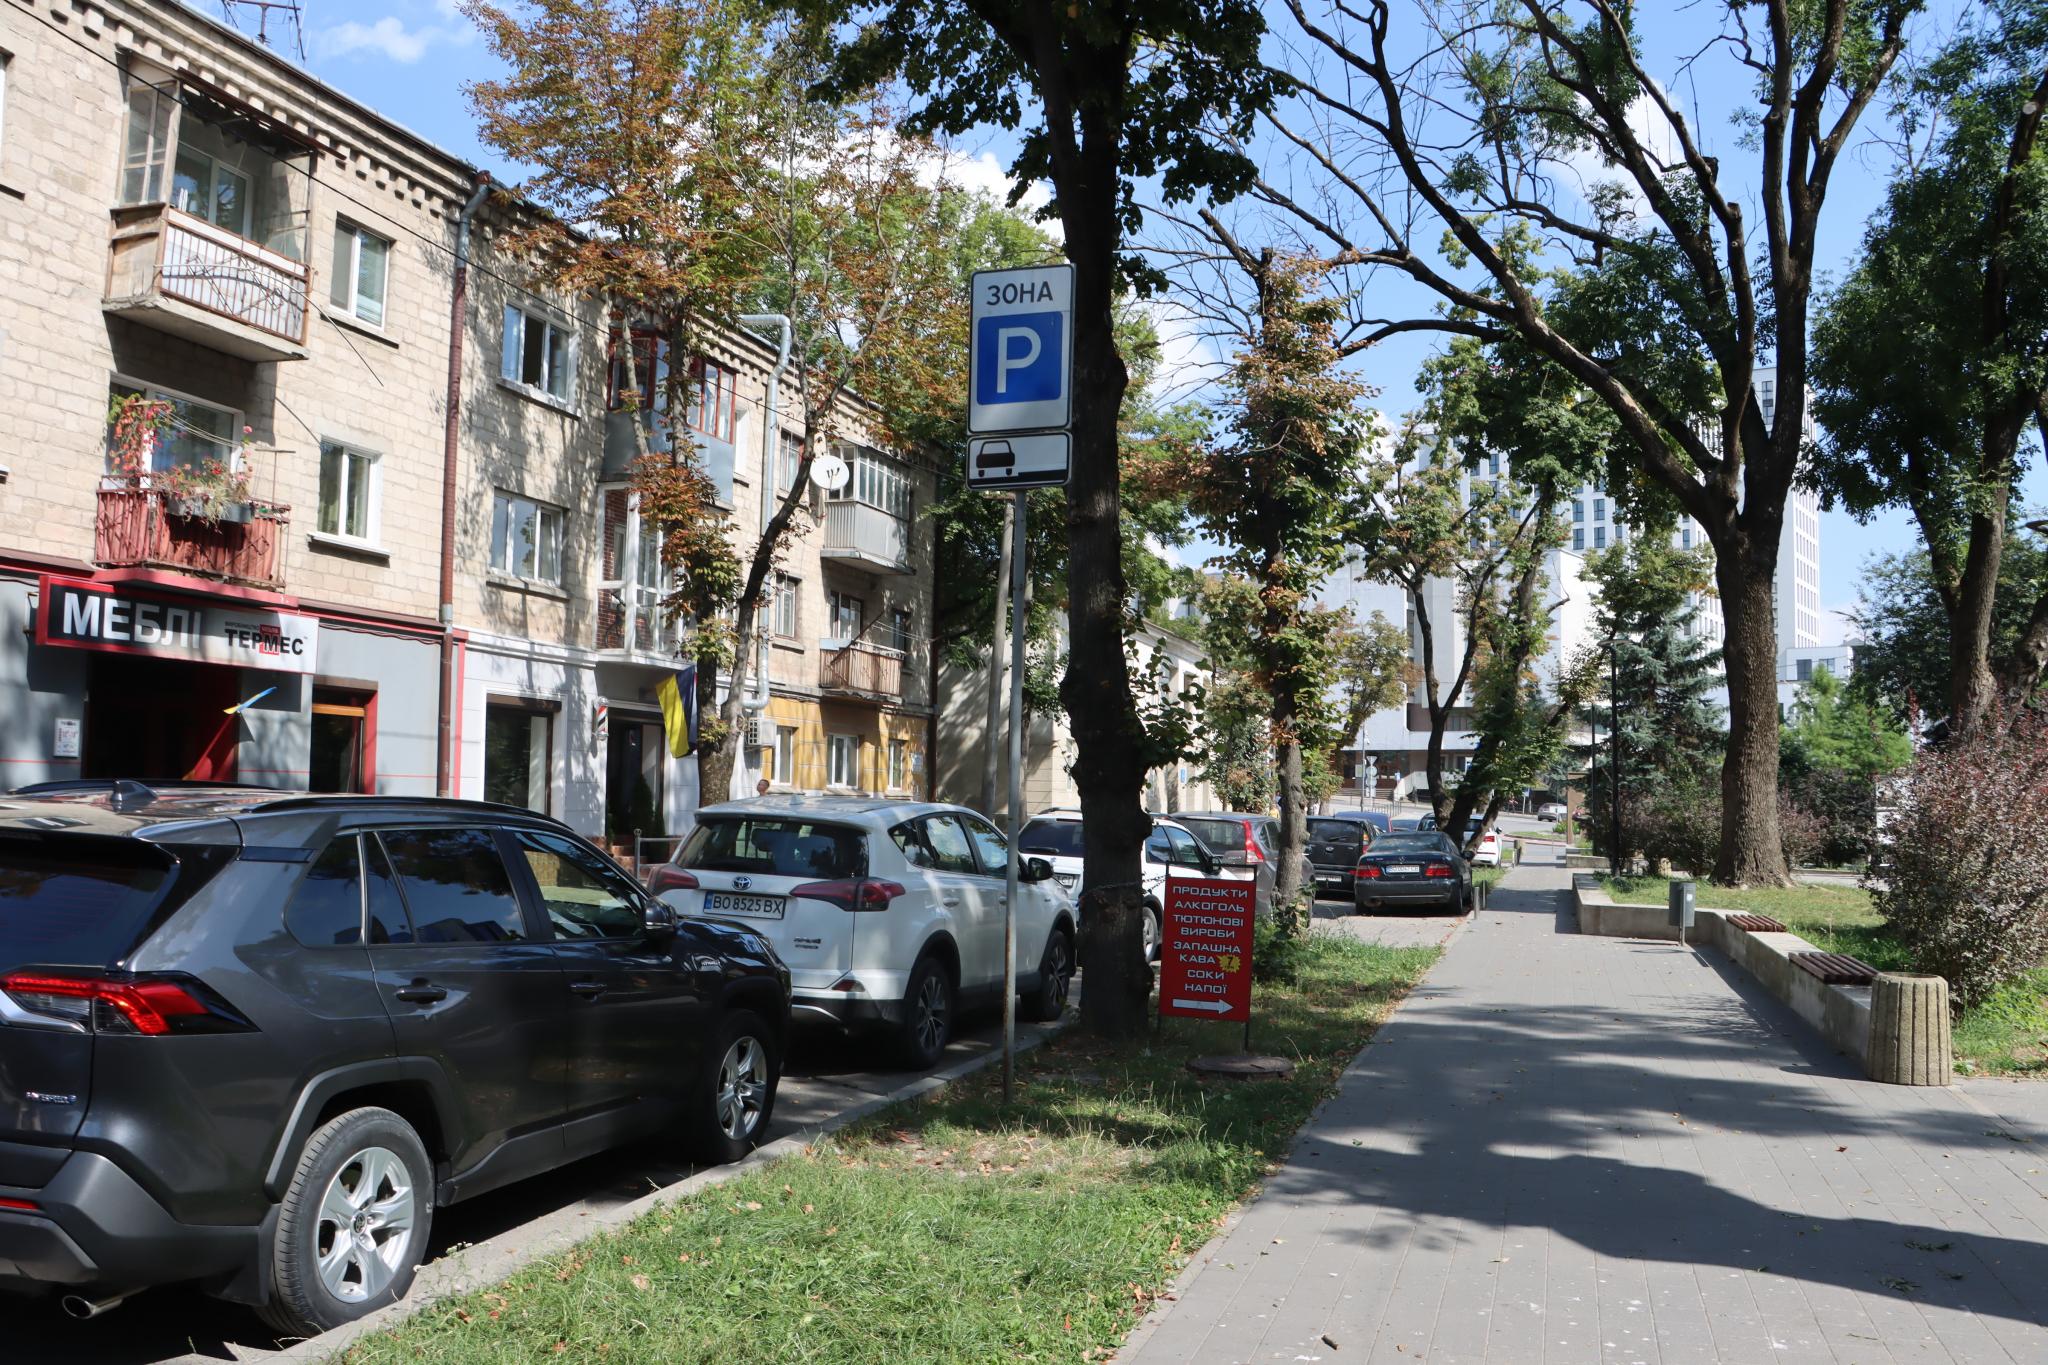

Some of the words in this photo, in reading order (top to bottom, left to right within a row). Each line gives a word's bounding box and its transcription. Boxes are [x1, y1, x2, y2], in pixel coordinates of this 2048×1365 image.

[986, 281, 1053, 306] ЗОНА
[997, 326, 1041, 394] P
[63, 592, 202, 649] МЕБЛІ
[225, 628, 304, 656] ТЕРМЕС
[1172, 886, 1248, 898] ПРОДУКТИ
[732, 898, 761, 912] 8525
[1174, 901, 1245, 913] АЛКОГОЛЬ
[1172, 914, 1244, 927] ТЮТЮНОВІ
[1180, 927, 1235, 939] ВИРОБИ
[1173, 941, 1241, 953] ЗАПАШНА
[1179, 954, 1216, 964] КАВА
[1187, 969, 1225, 979] СОКИ
[1184, 983, 1227, 994] НАПОЇ
